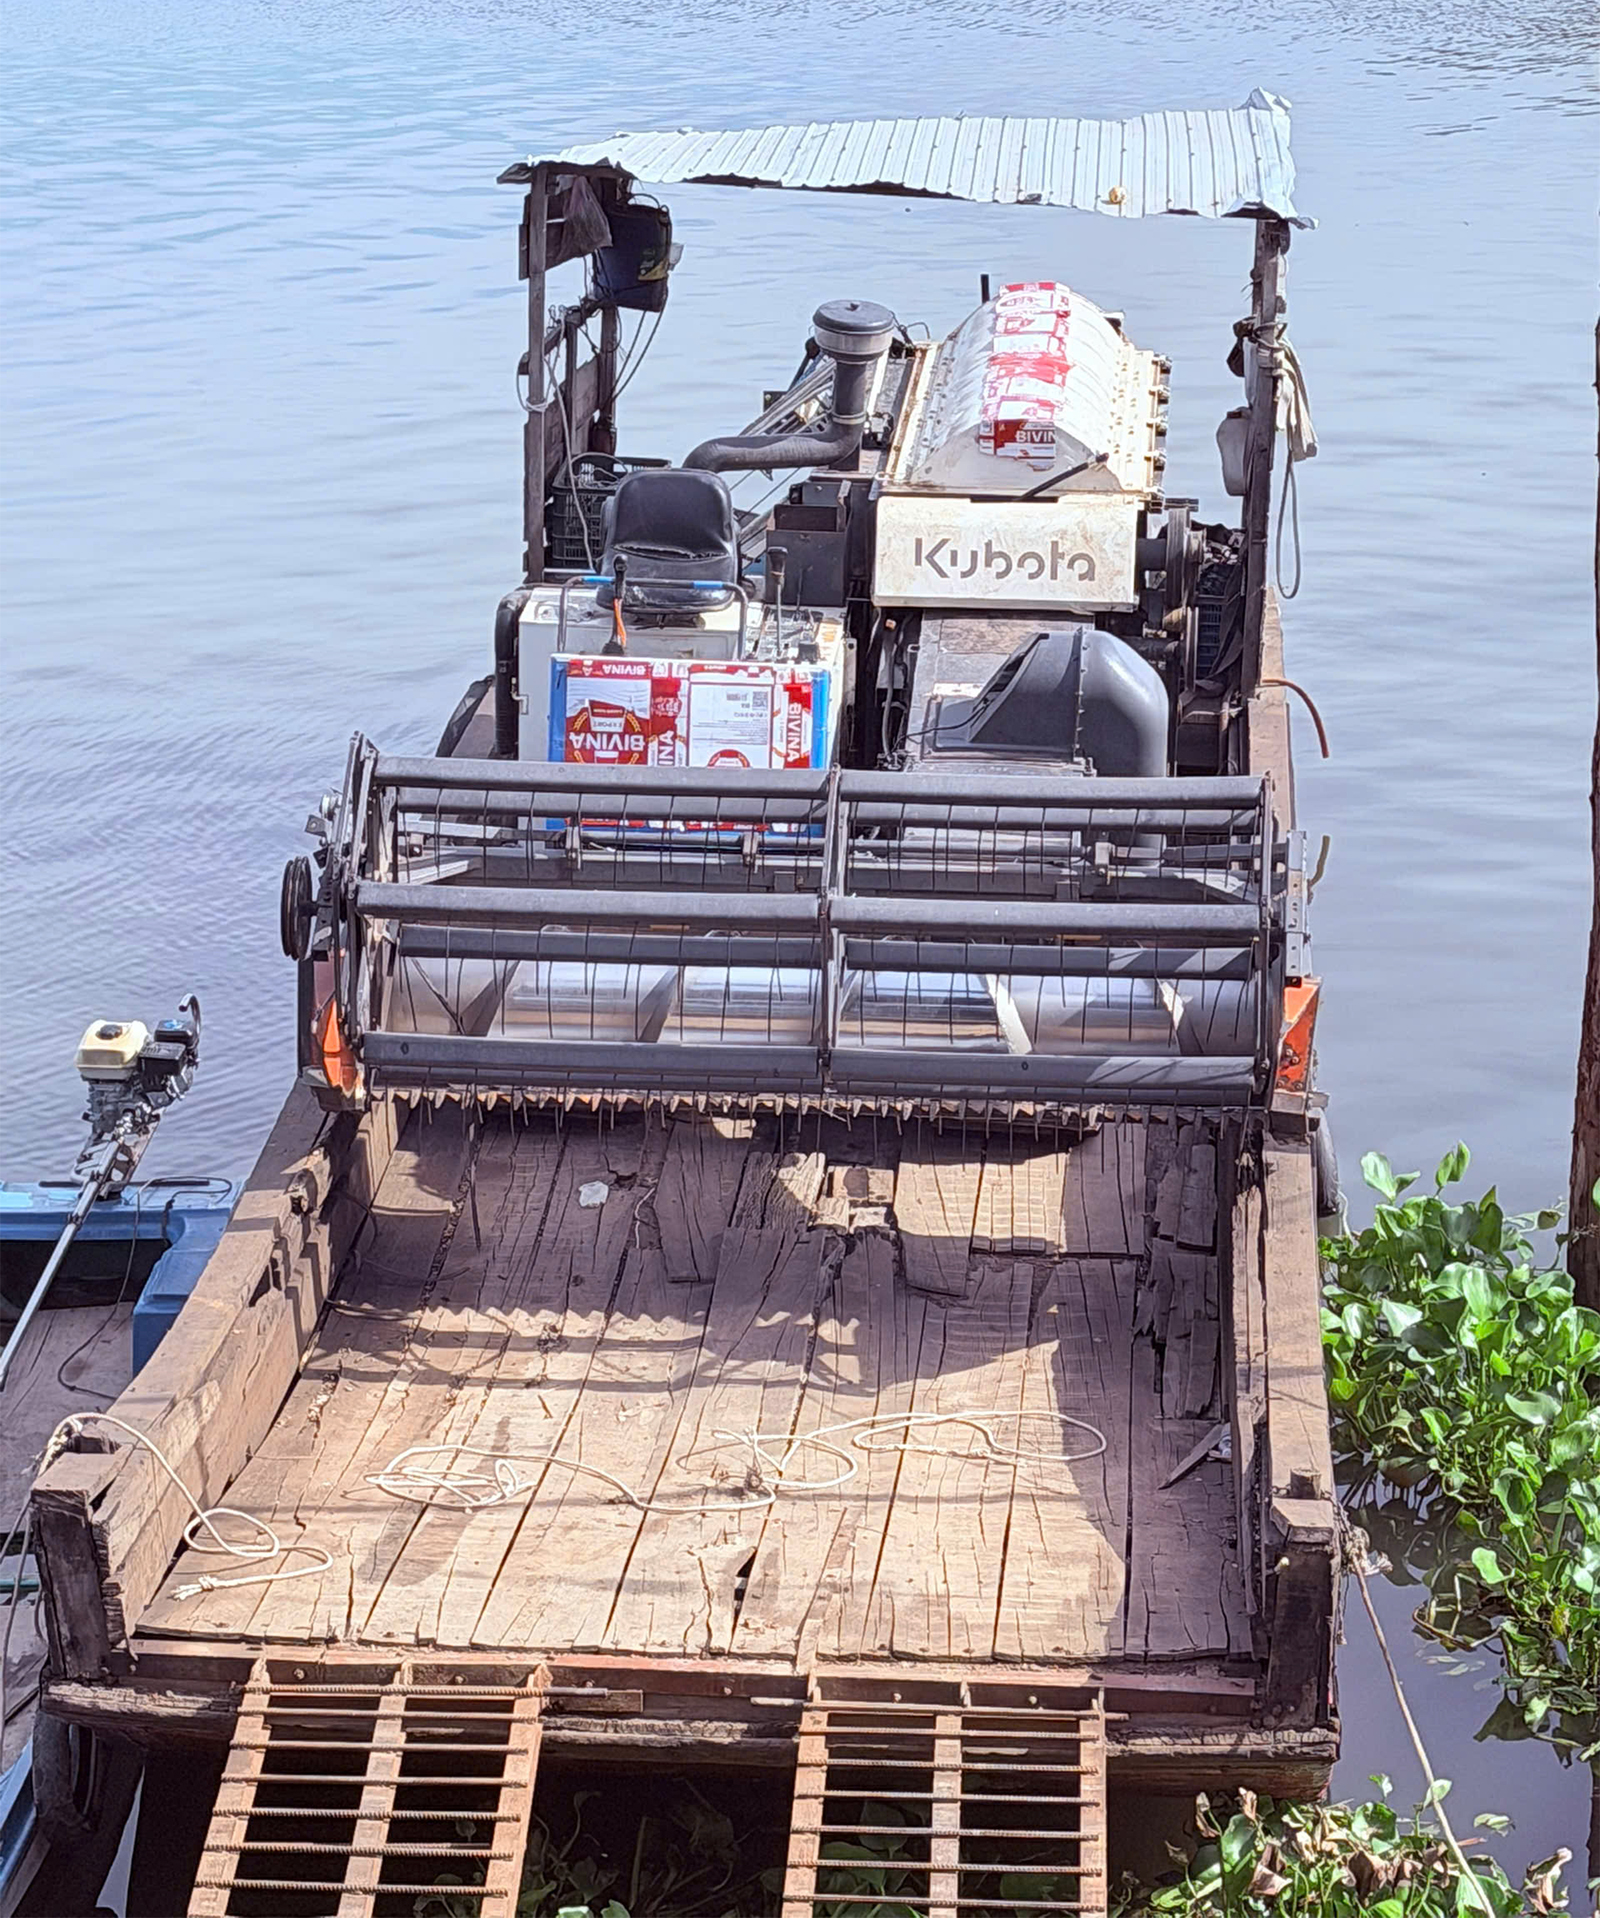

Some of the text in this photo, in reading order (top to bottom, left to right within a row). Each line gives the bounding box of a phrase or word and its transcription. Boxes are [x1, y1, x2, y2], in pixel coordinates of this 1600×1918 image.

[914, 537, 1096, 582] Kubota
[602, 664, 647, 676] BIVINA
[569, 732, 646, 751] BIVINA
[788, 702, 802, 762] BIVINA
